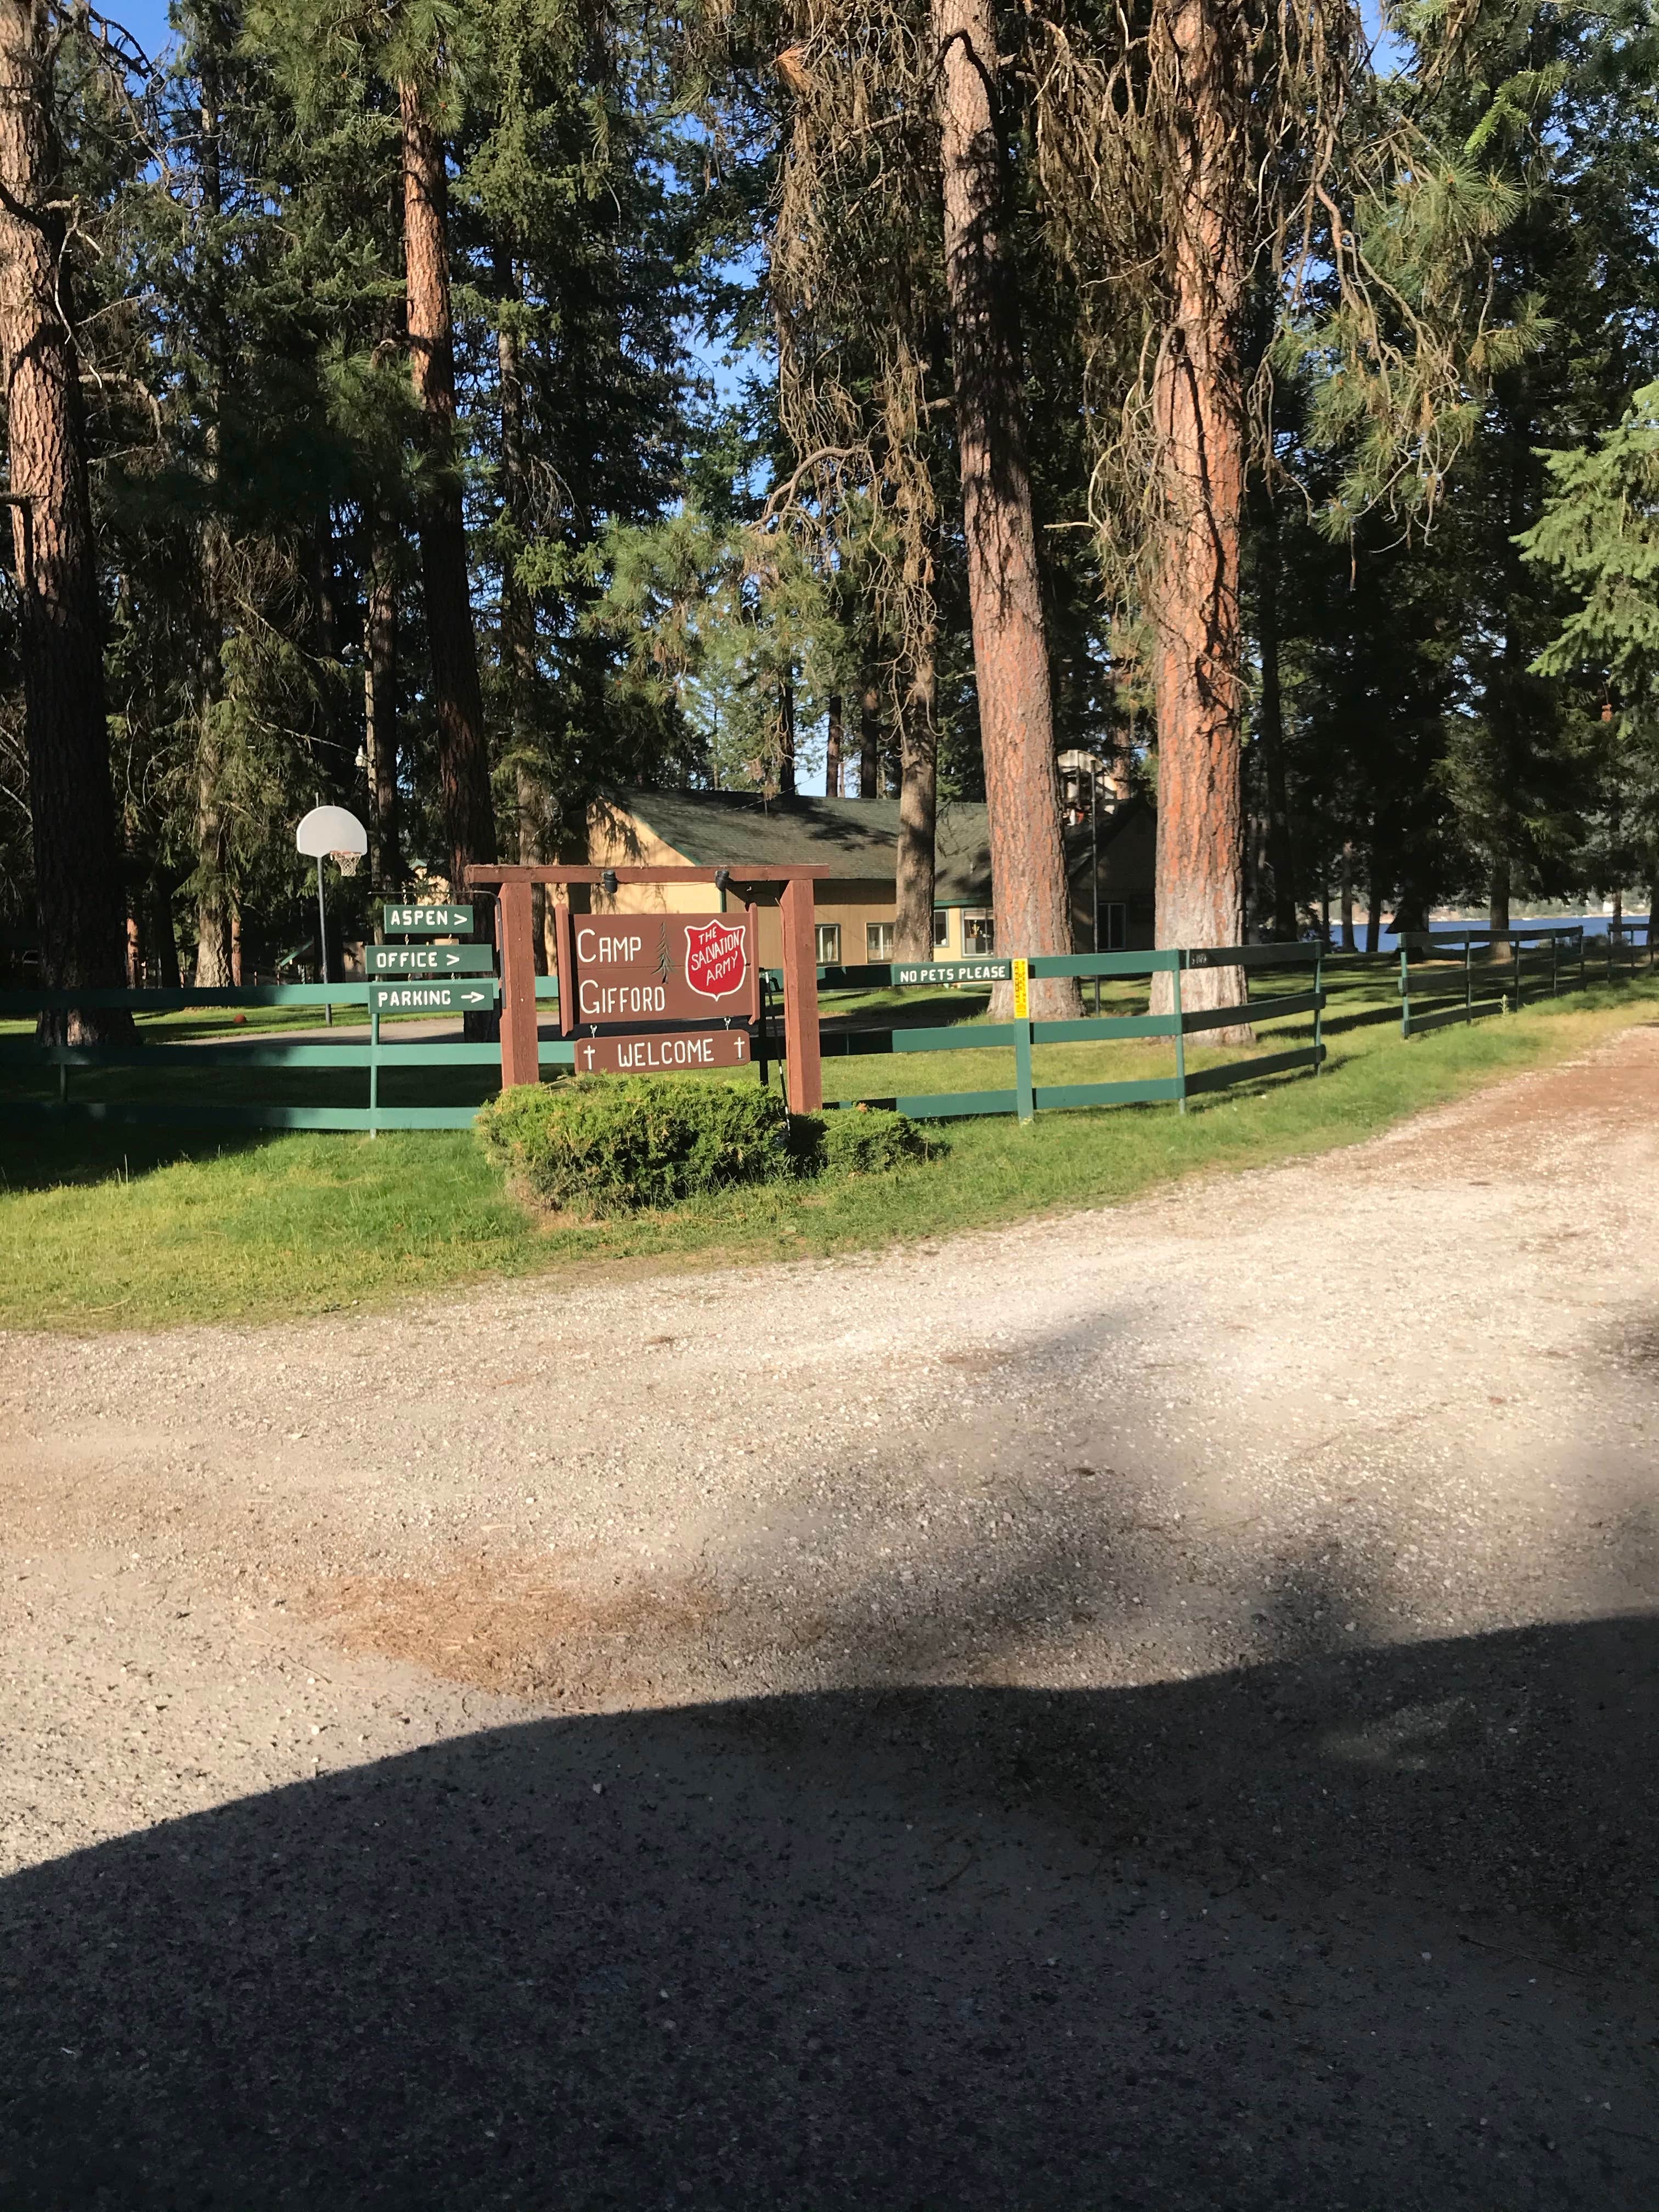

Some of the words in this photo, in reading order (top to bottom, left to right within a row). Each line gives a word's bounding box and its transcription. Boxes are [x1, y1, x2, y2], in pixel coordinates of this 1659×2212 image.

[391, 910, 448, 926] ASPEN
[578, 928, 641, 963] CAMP
[698, 926, 717, 945] THE
[376, 952, 438, 968] OFFICE
[691, 930, 740, 971] SALVATION
[706, 950, 738, 986] ARMY
[900, 970, 917, 983] NO
[921, 968, 954, 981] PETS
[959, 966, 1006, 979] PLEASE
[378, 990, 451, 1007] PARKING
[579, 979, 665, 1014] GIFFORD
[618, 1038, 714, 1067] WELCOME
